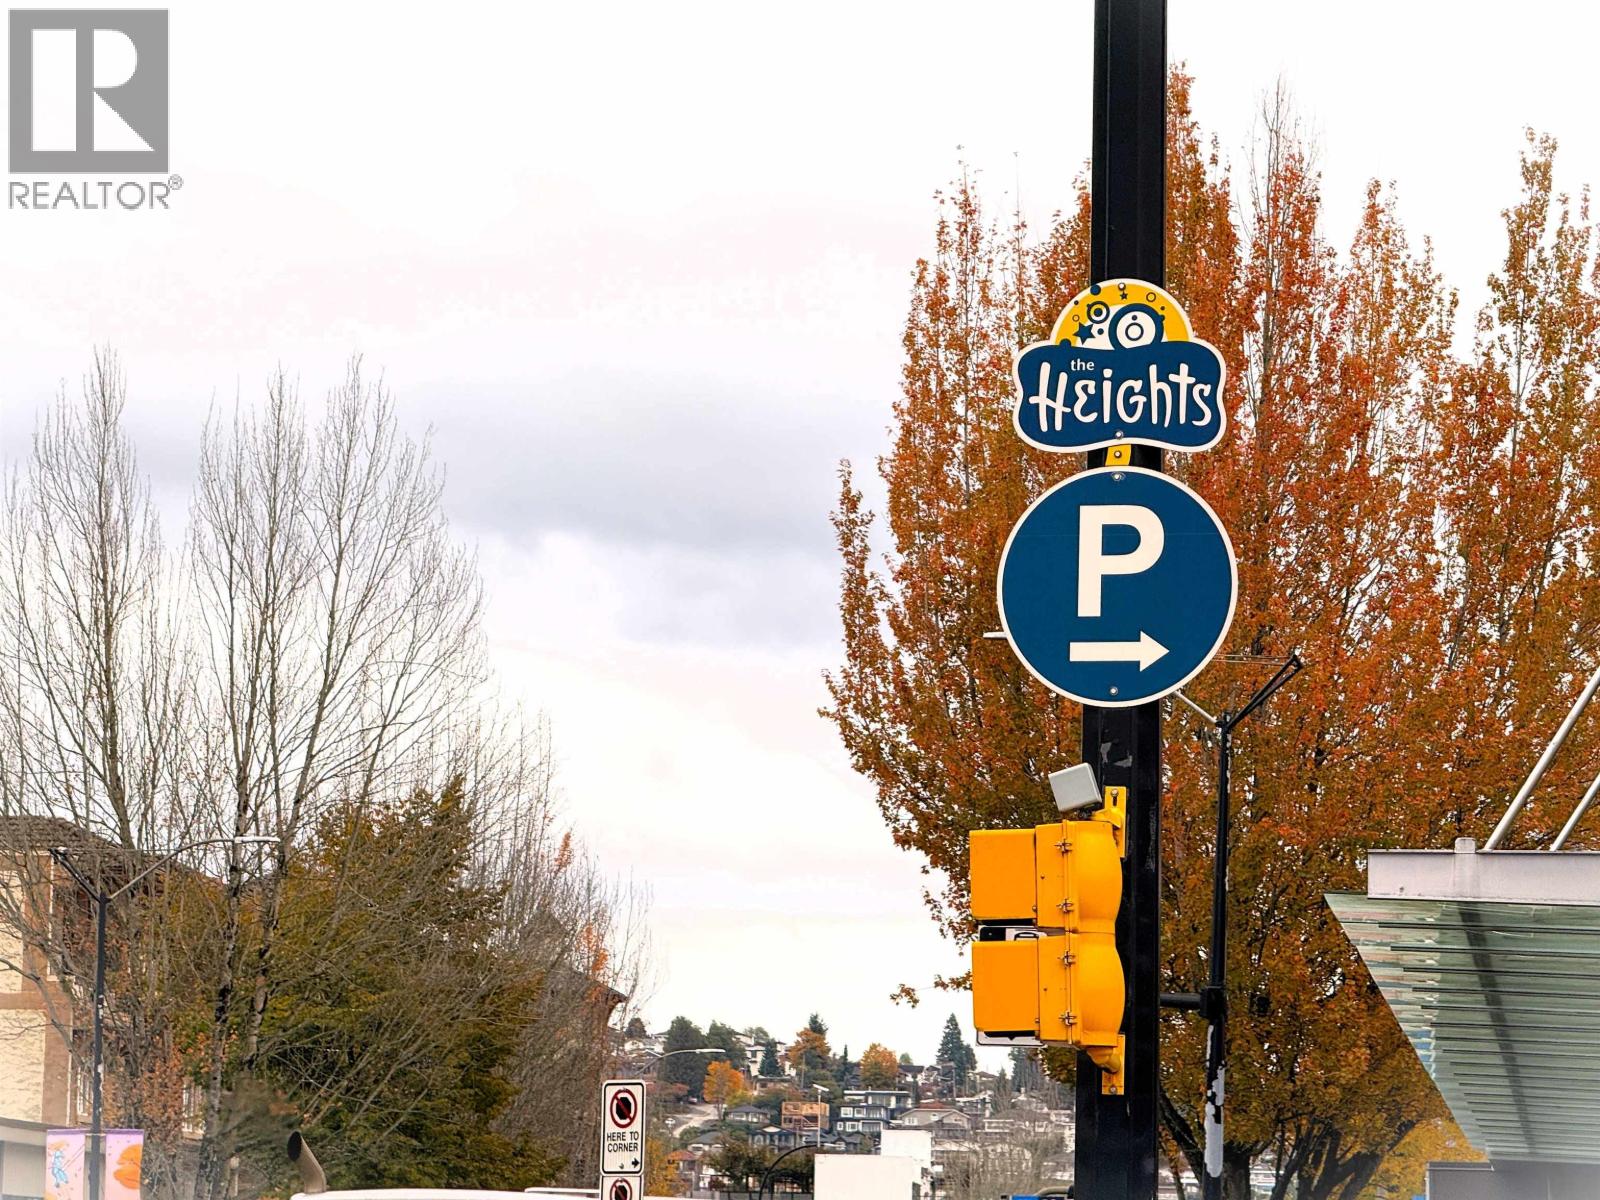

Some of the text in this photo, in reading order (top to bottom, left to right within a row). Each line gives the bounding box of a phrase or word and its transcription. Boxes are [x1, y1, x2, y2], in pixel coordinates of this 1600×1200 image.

[1070, 358, 1095, 371] the
[1077, 504, 1165, 618] P
[606, 1131, 640, 1141] HERE TO
[607, 1142, 639, 1152] CORNER
